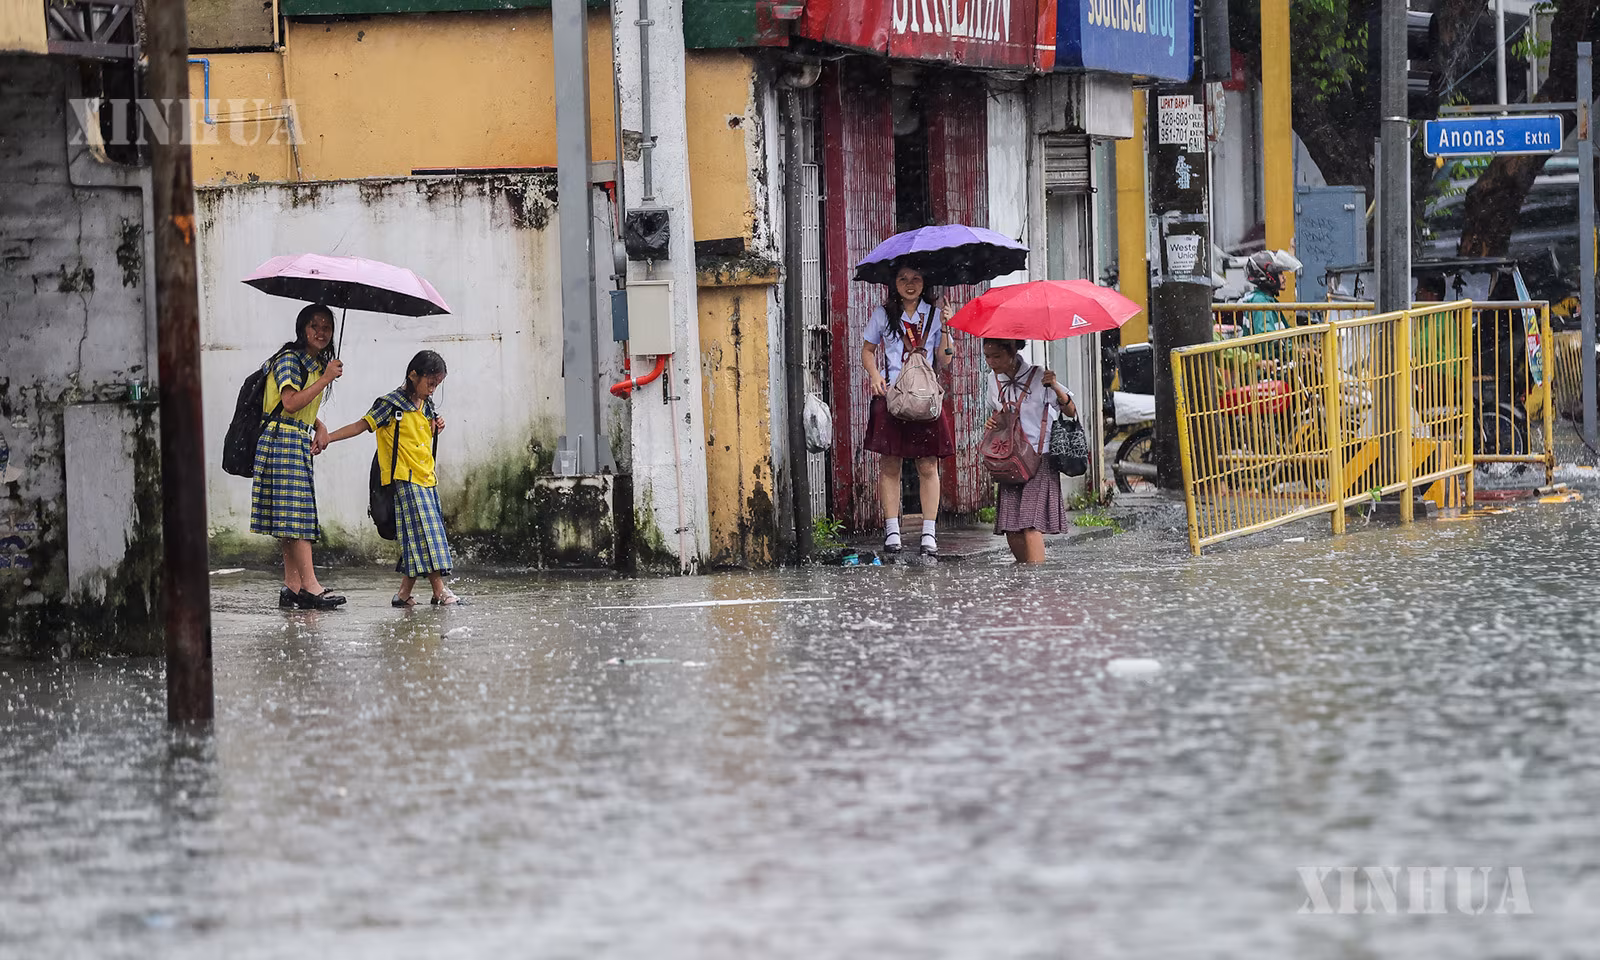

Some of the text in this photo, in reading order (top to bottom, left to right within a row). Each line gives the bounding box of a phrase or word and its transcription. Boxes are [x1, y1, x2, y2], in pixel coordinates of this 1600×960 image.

[1439, 128, 1551, 148] Anonas Extn
[1170, 243, 1197, 252] Weste
